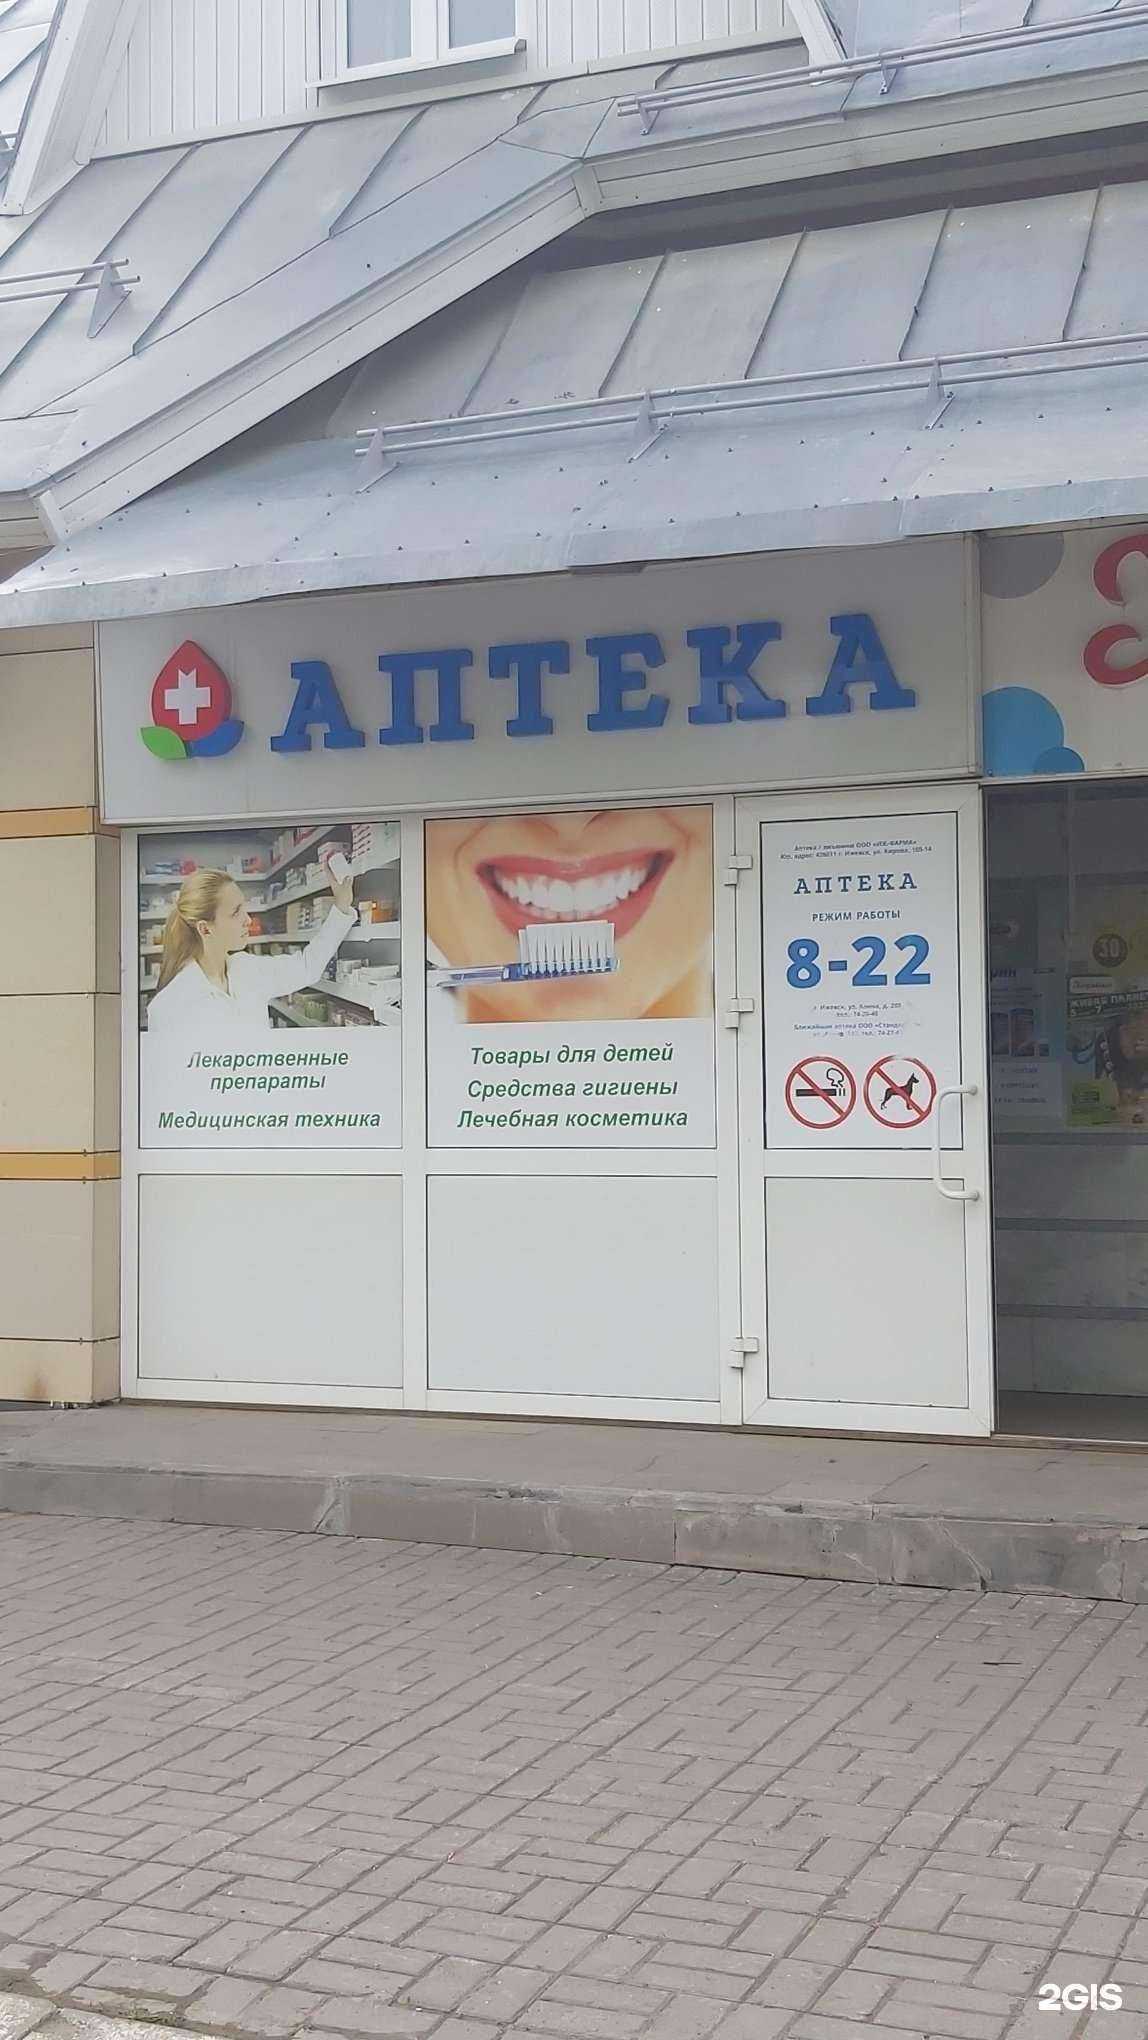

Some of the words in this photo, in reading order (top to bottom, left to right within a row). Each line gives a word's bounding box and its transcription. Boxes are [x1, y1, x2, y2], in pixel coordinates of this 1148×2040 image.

[269, 612, 918, 753] АПТЕКА
[794, 873, 917, 895] АПТЕКА
[812, 911, 852, 922] РЕЖИМ
[857, 909, 901, 920] РАБОТЫ
[786, 934, 931, 989] 8-22
[187, 1051, 349, 1071] Лекарственные
[470, 1047, 550, 1068] Товары
[557, 1044, 596, 1063] для
[603, 1042, 674, 1062] детей
[210, 1073, 326, 1094] препараты
[467, 1079, 576, 1101] Средства
[582, 1080, 678, 1096] гигиены
[158, 1111, 289, 1131] Медицинская
[295, 1112, 381, 1128] техника
[457, 1109, 559, 1128] Лечебная
[565, 1111, 689, 1127] косметика
